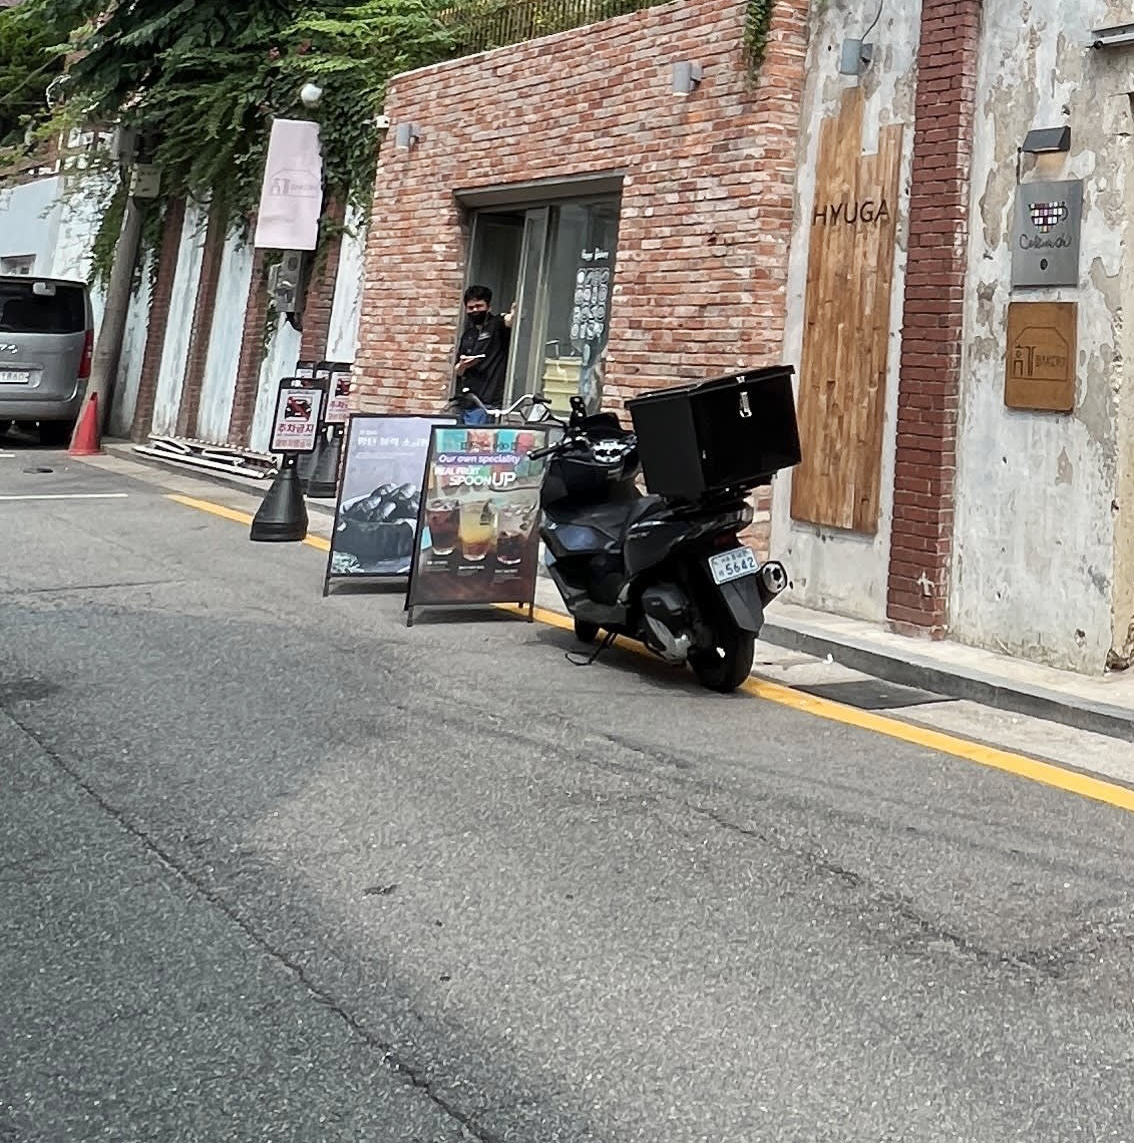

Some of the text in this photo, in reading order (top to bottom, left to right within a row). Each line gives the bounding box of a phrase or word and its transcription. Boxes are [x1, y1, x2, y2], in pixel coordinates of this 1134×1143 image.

[812, 199, 890, 226] HYUGA
[439, 454, 456, 463] Our
[478, 455, 520, 464] speciality
